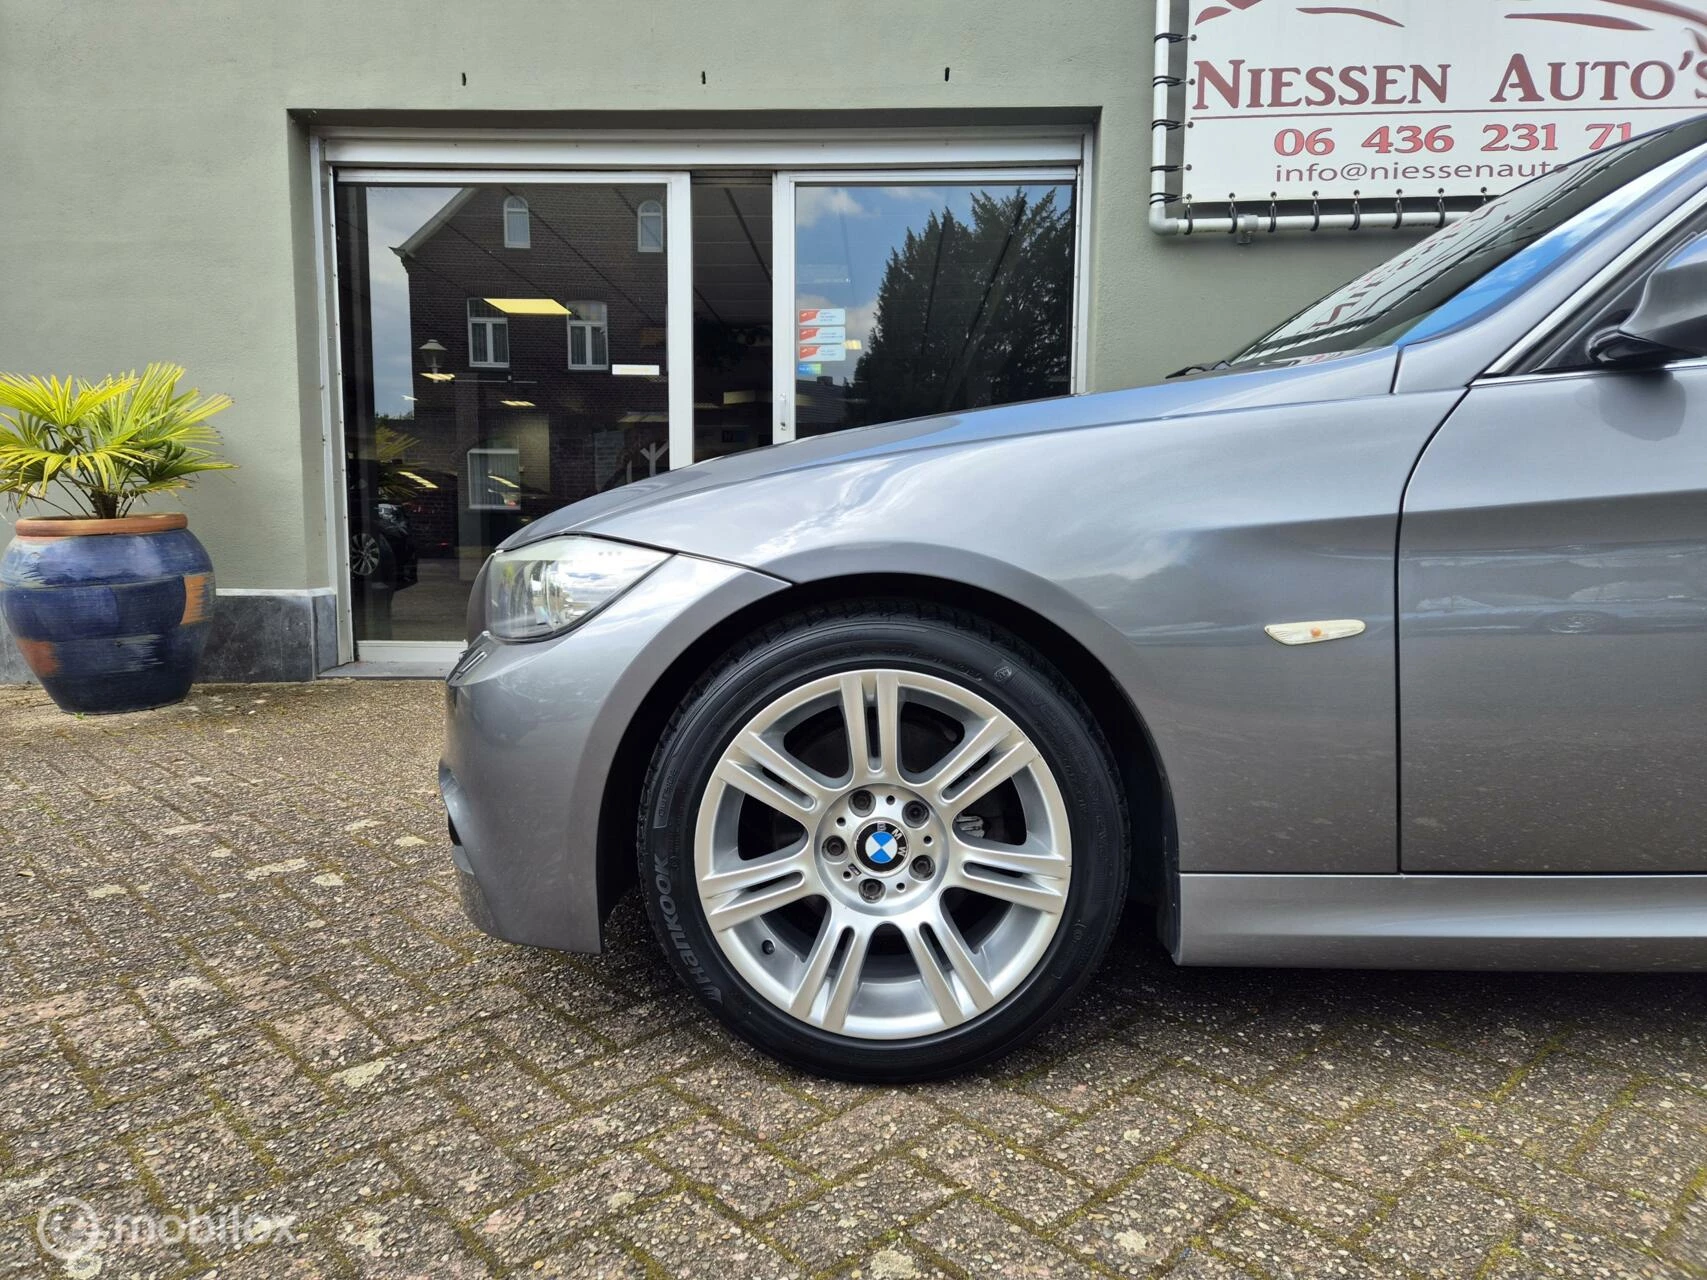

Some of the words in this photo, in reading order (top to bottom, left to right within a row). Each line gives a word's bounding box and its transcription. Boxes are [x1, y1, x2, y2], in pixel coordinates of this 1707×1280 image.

[1191, 59, 1452, 110] NIESSEN
[1273, 127, 1335, 157] 06
[1360, 124, 1455, 154] 436
[1480, 122, 1559, 152] 231
[1584, 121, 1632, 151] 71
[876, 822, 907, 857] BMW
